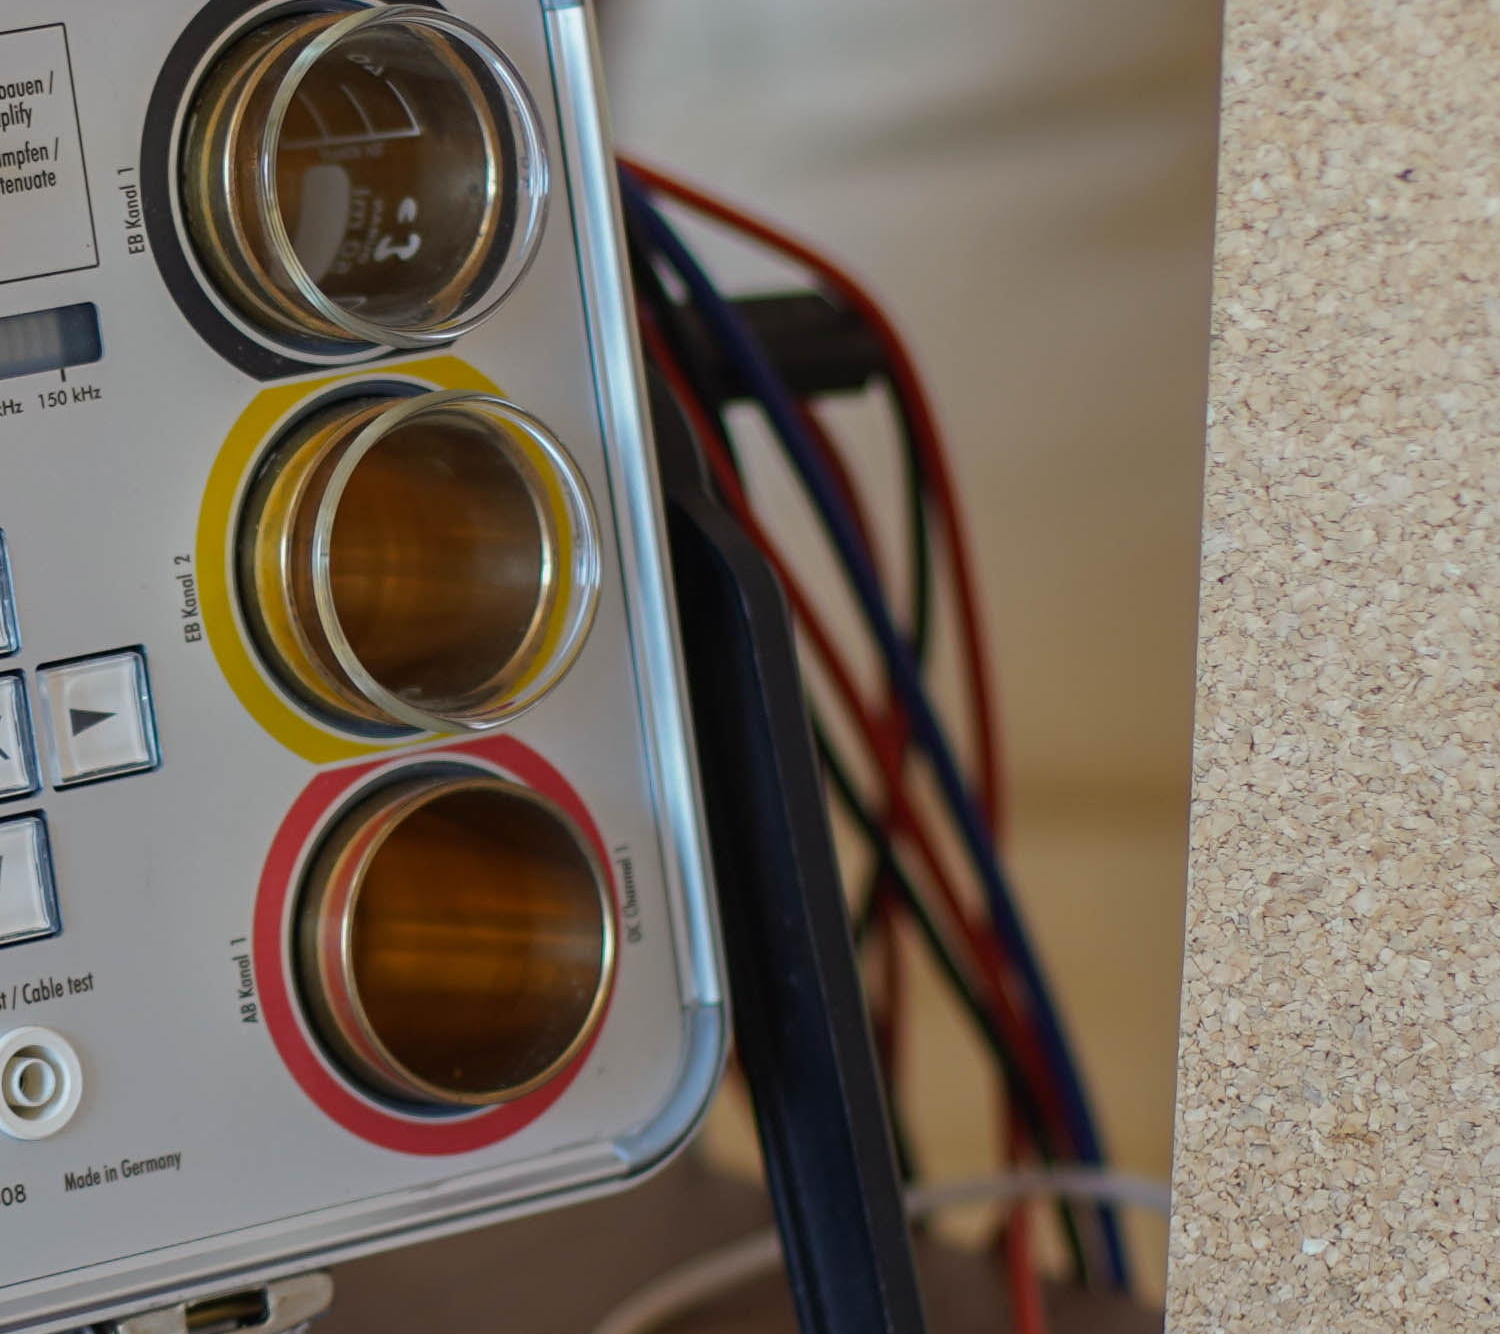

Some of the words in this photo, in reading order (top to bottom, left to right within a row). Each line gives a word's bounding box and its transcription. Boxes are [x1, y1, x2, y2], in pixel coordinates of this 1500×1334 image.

[119, 185, 142, 229] Kanal
[128, 234, 145, 254] EB
[38, 391, 68, 409] 150
[72, 385, 102, 404] kHz
[174, 554, 191, 565] 2
[176, 574, 198, 619] Kanal
[184, 622, 202, 643] EB
[22, 978, 64, 1007] Cable
[68, 972, 94, 998] test
[232, 955, 254, 999] Kanal
[241, 1003, 258, 1023] AB
[64, 1169, 100, 1192] Made
[104, 1164, 118, 1183] in
[121, 1150, 182, 1182] Germany
